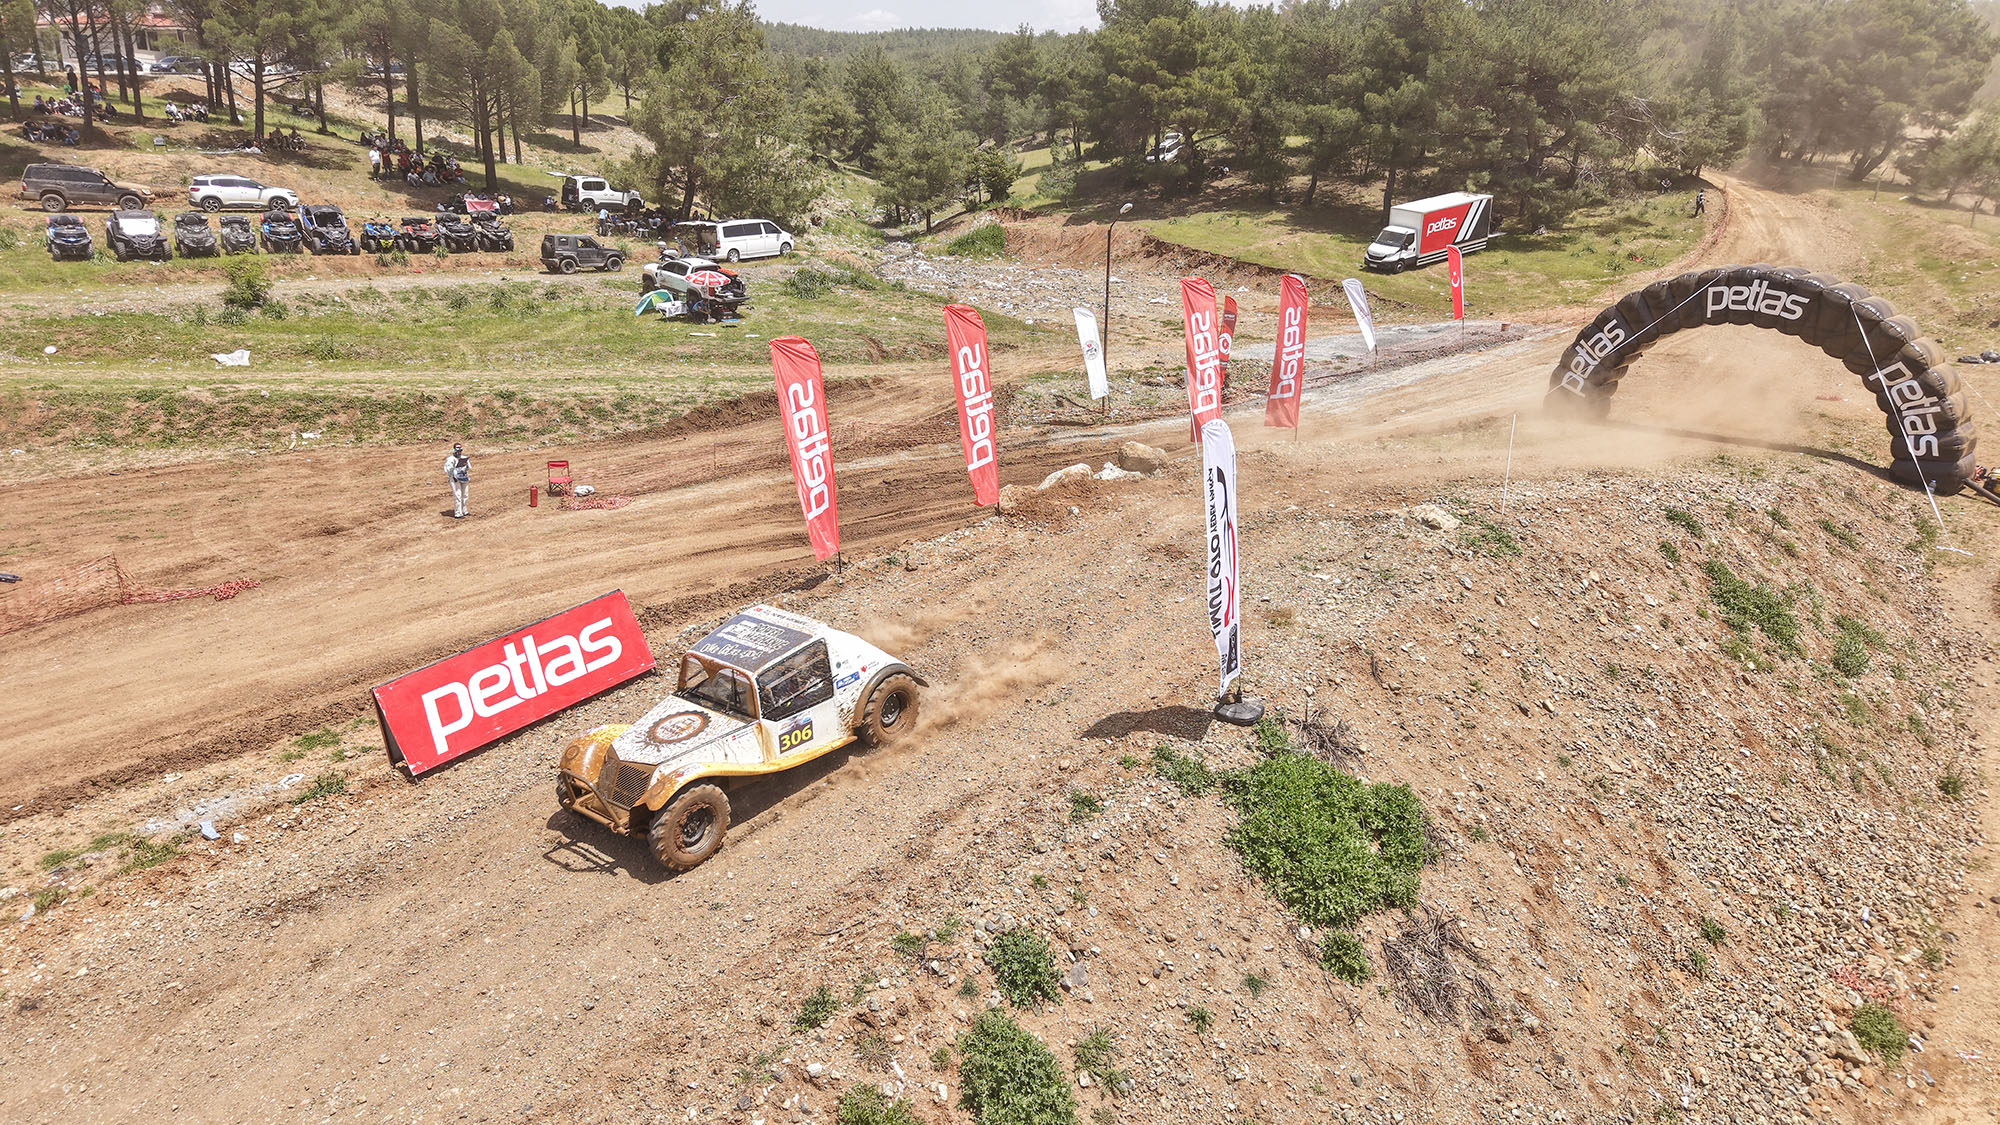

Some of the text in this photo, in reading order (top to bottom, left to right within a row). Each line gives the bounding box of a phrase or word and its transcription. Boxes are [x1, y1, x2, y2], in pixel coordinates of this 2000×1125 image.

[1426, 217, 1458, 237] petlas
[1706, 279, 1811, 320] petlas
[1562, 318, 1627, 398] petlas
[1868, 360, 1941, 457] petlas
[421, 616, 623, 756] petlas
[780, 724, 812, 751] 306
